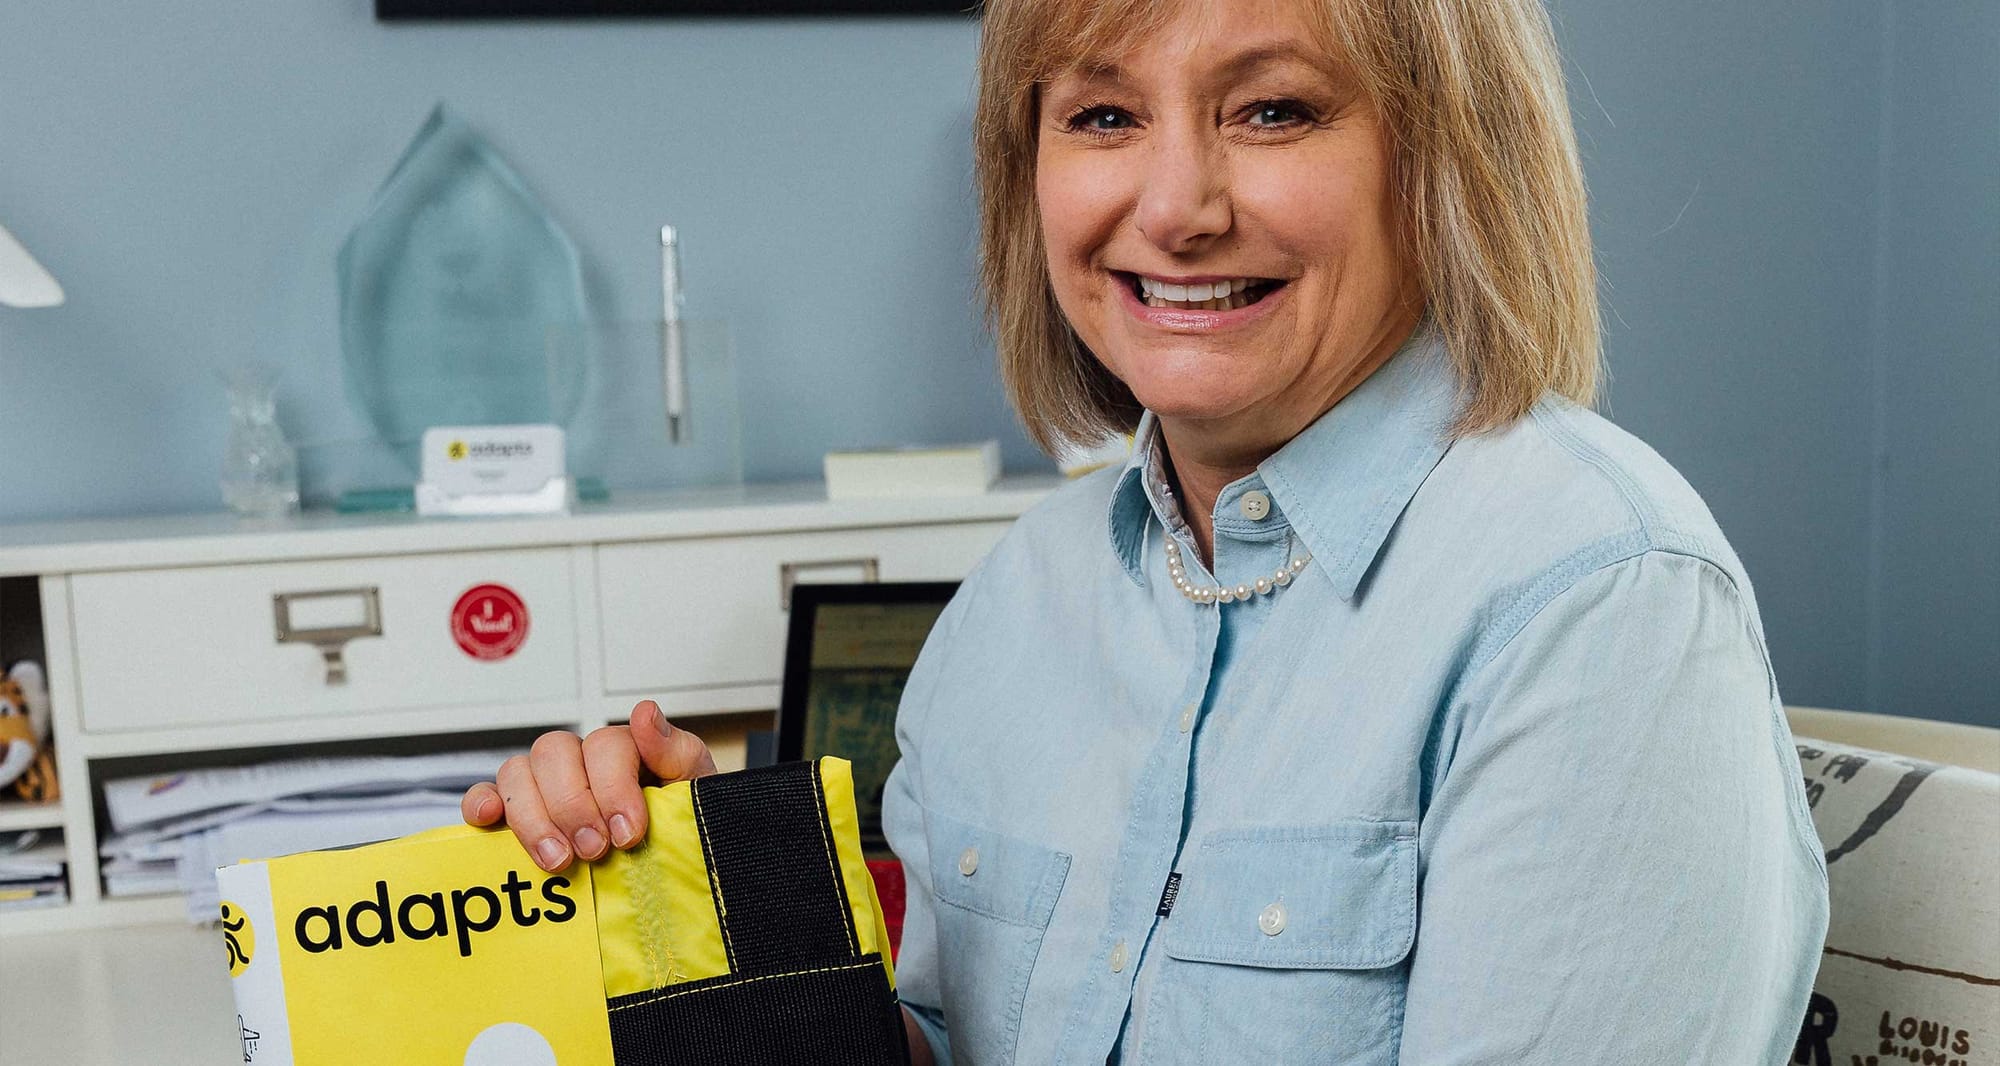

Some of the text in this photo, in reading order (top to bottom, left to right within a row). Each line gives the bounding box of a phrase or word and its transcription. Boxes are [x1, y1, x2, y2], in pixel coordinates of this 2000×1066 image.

[294, 870, 577, 957] adapts
[1160, 876, 1179, 910] LAUREN
[1879, 1010, 1970, 1055] LOUIS
